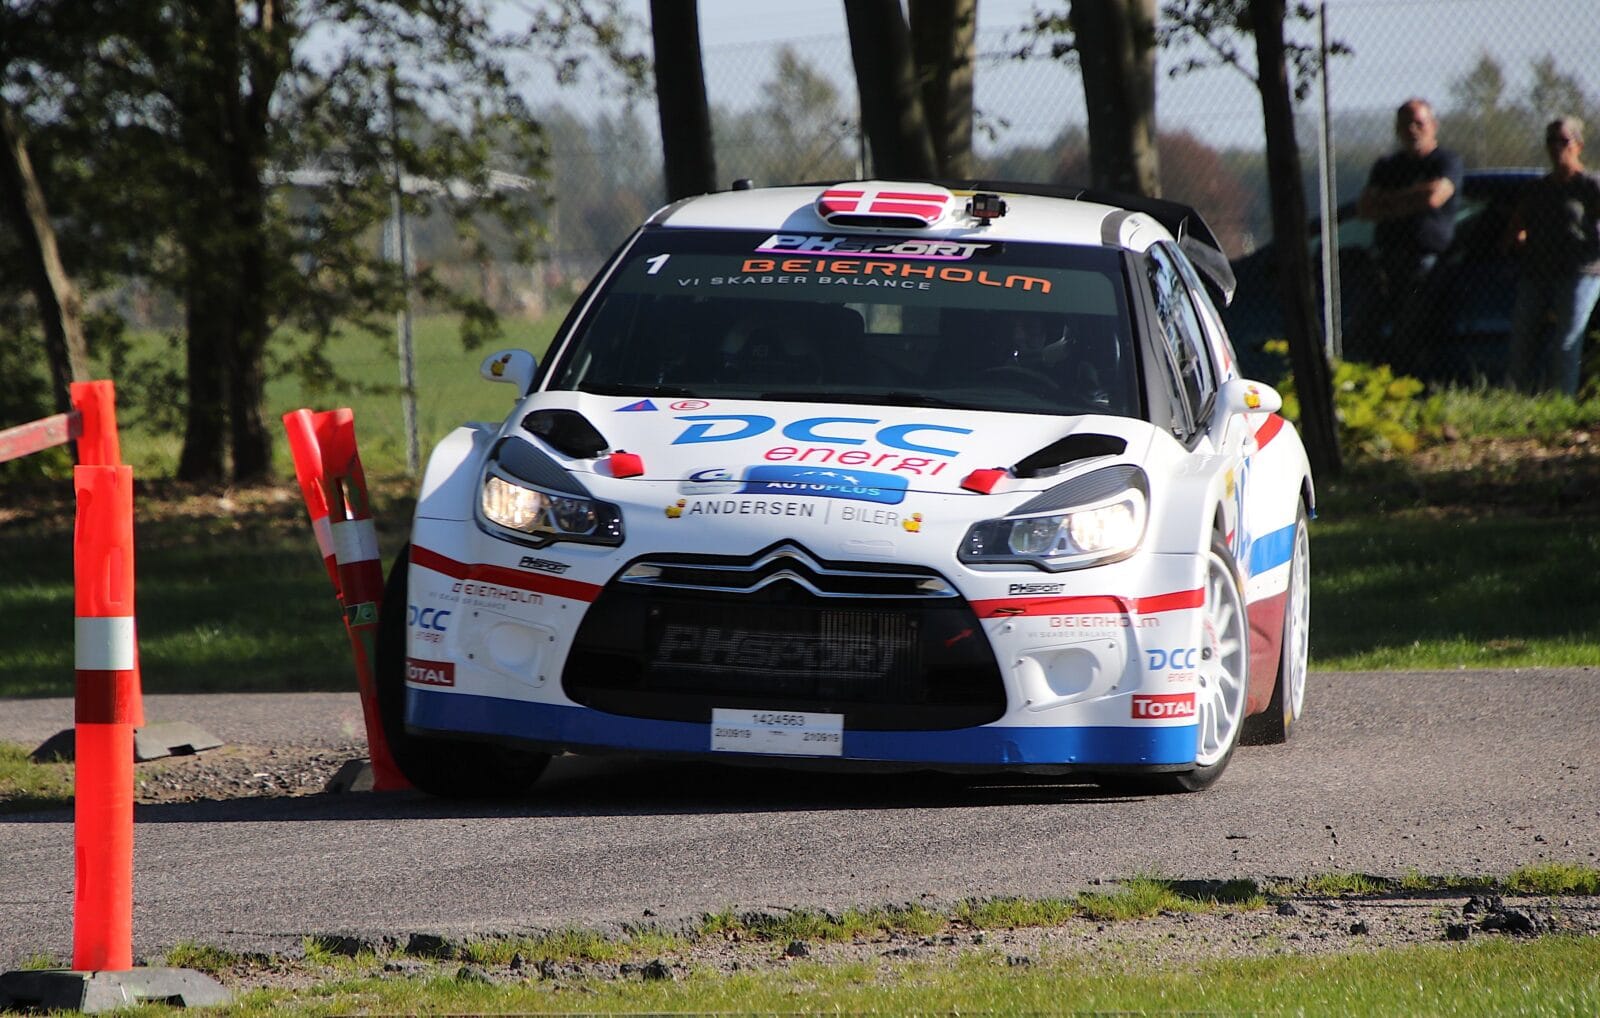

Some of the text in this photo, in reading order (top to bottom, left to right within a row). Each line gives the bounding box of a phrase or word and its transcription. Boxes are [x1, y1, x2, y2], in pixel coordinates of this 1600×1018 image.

[756, 234, 995, 259] PHSPORT
[646, 253, 670, 274] 1
[678, 276, 931, 290] VI SKABER BALANCE
[741, 259, 1052, 294] BEIERHOLM
[671, 414, 974, 457] DCC
[764, 446, 950, 476] energi
[766, 482, 881, 496] AUTOPLUS
[689, 500, 899, 527] ANDERSEN BILER
[1145, 648, 1197, 670] DCC
[1134, 699, 1194, 716] TOTAL
[752, 714, 805, 726] 1424563
